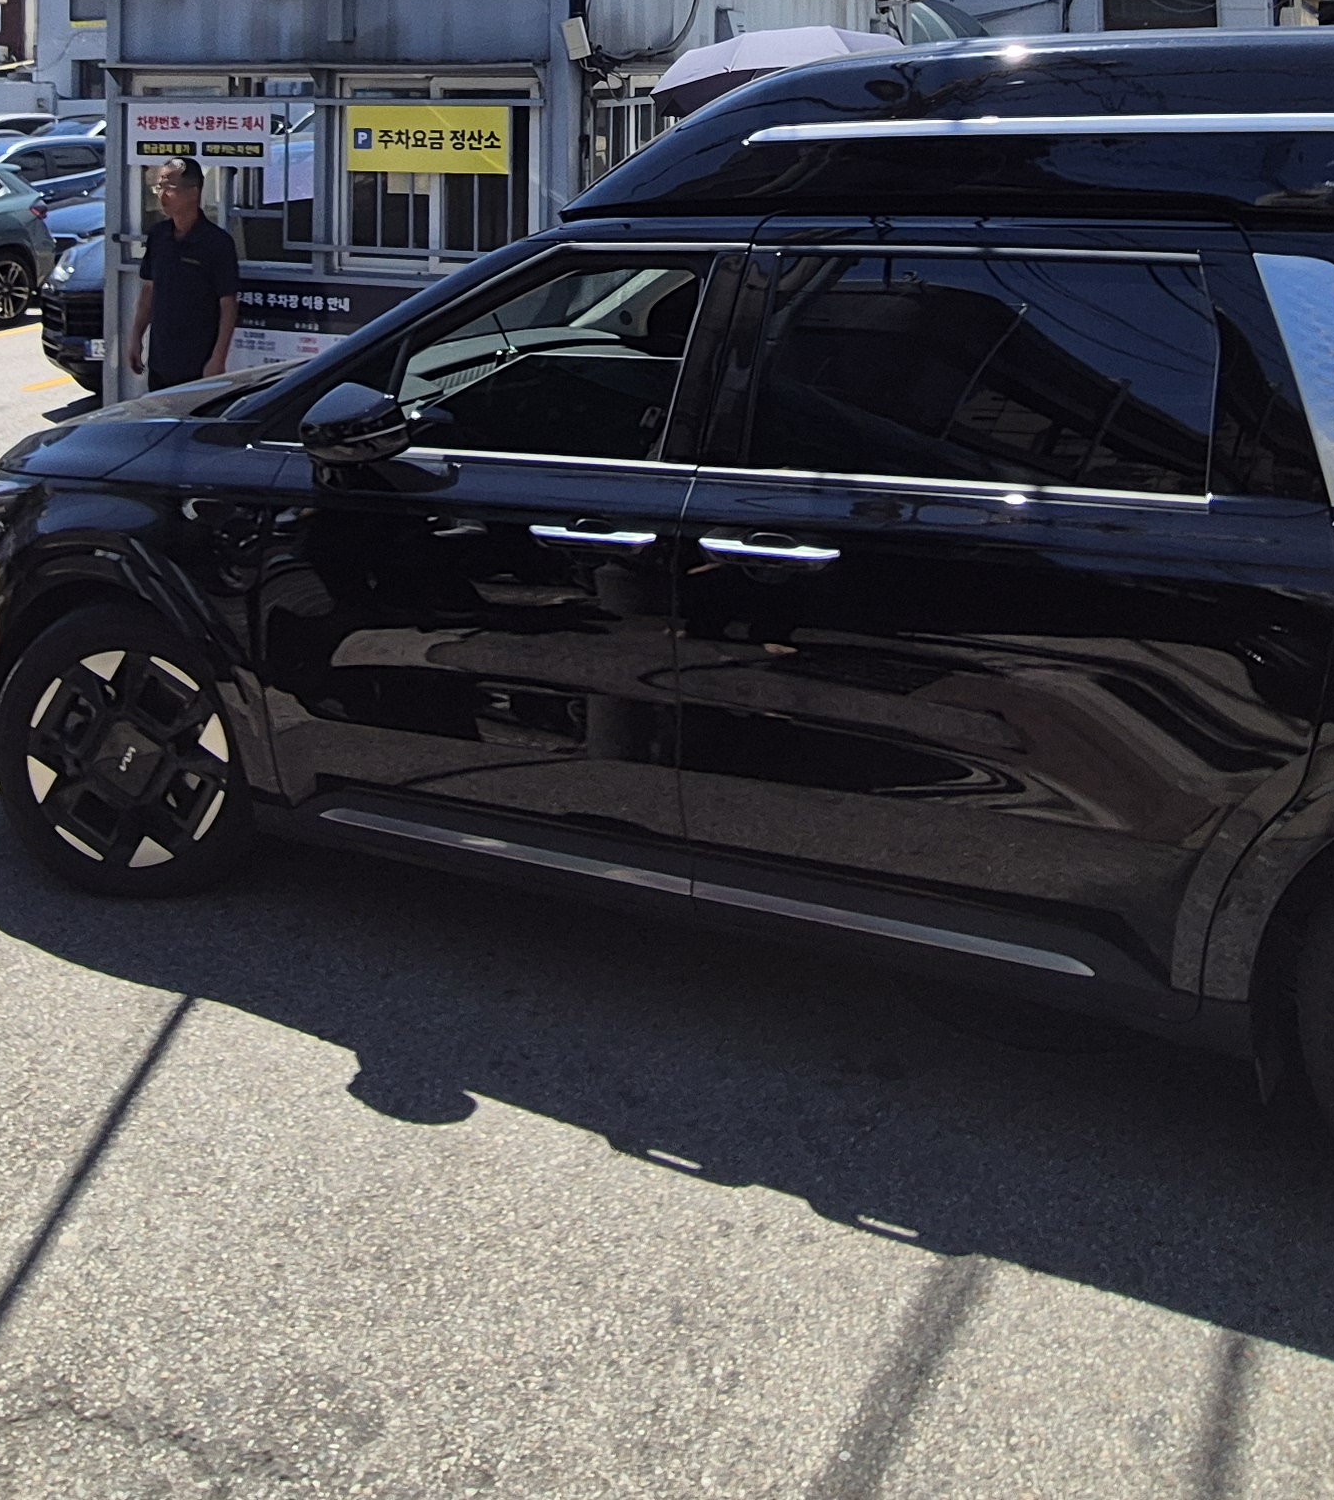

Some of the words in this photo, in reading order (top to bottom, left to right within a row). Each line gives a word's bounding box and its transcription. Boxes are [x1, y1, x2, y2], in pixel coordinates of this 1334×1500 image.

[136, 115, 181, 131] 차량번호
[193, 115, 240, 131] 신용카드
[241, 115, 265, 131] 제시
[377, 129, 445, 150] 주차요금
[449, 129, 502, 151] 정산소
[267, 293, 300, 309] 주차장
